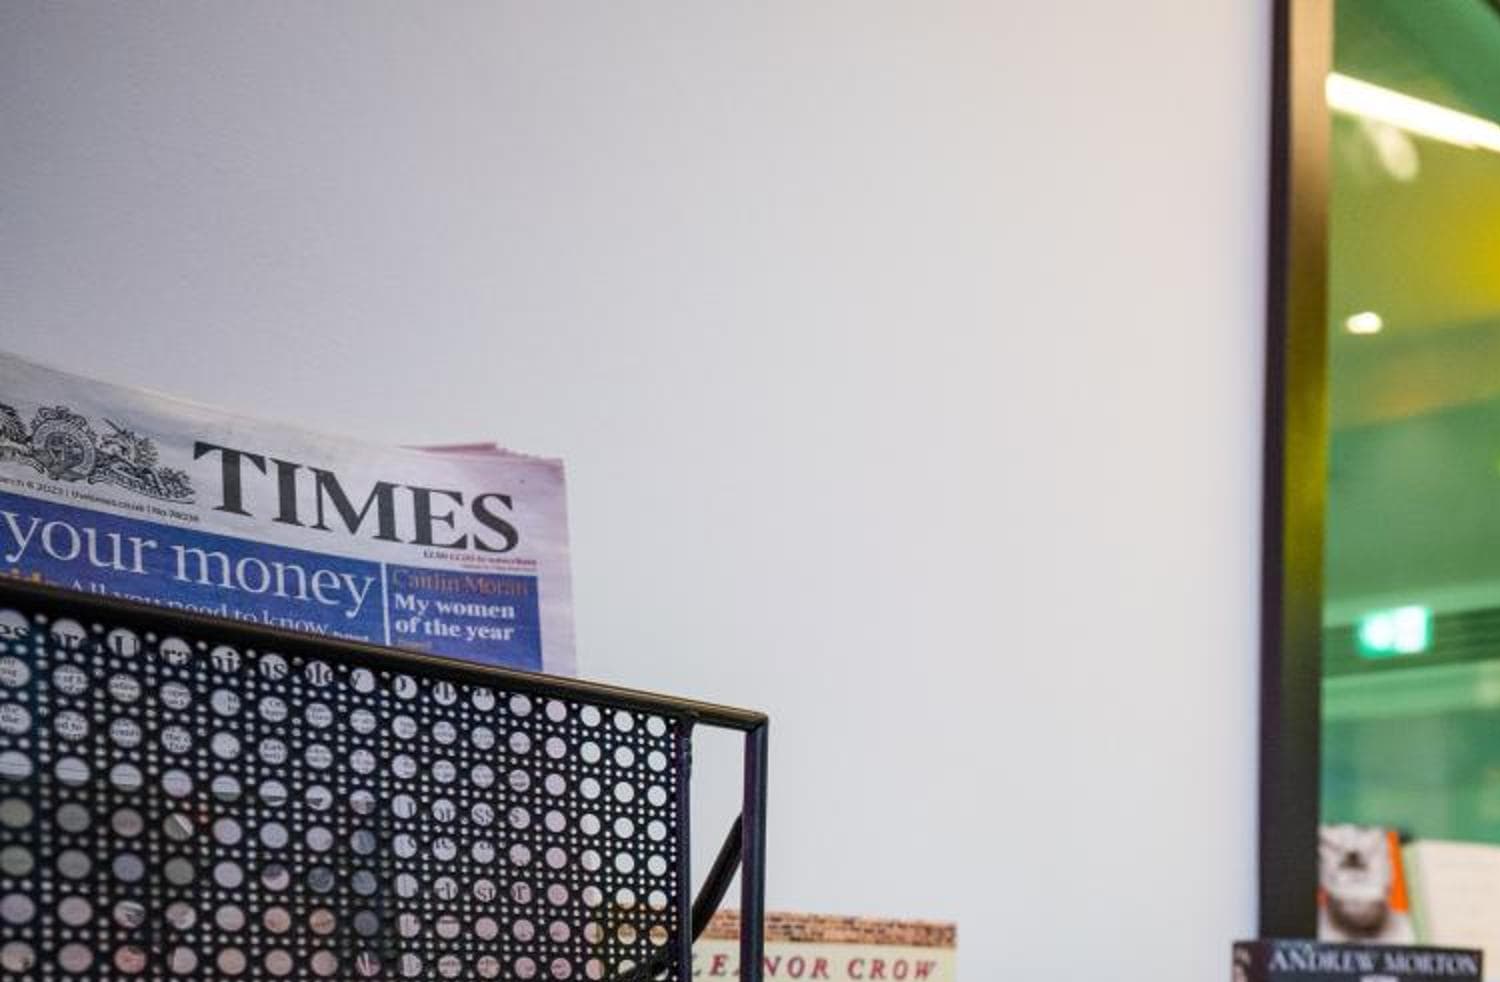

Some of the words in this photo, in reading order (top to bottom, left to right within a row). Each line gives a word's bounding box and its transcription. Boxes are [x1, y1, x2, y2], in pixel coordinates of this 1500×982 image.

[194, 440, 519, 553] TIMES
[0, 510, 158, 575] your
[169, 543, 376, 619] money
[394, 592, 429, 616] My
[435, 600, 515, 618] women
[395, 615, 421, 633] of
[424, 617, 460, 637] the
[465, 623, 515, 641] year
[847, 958, 937, 981] CROW
